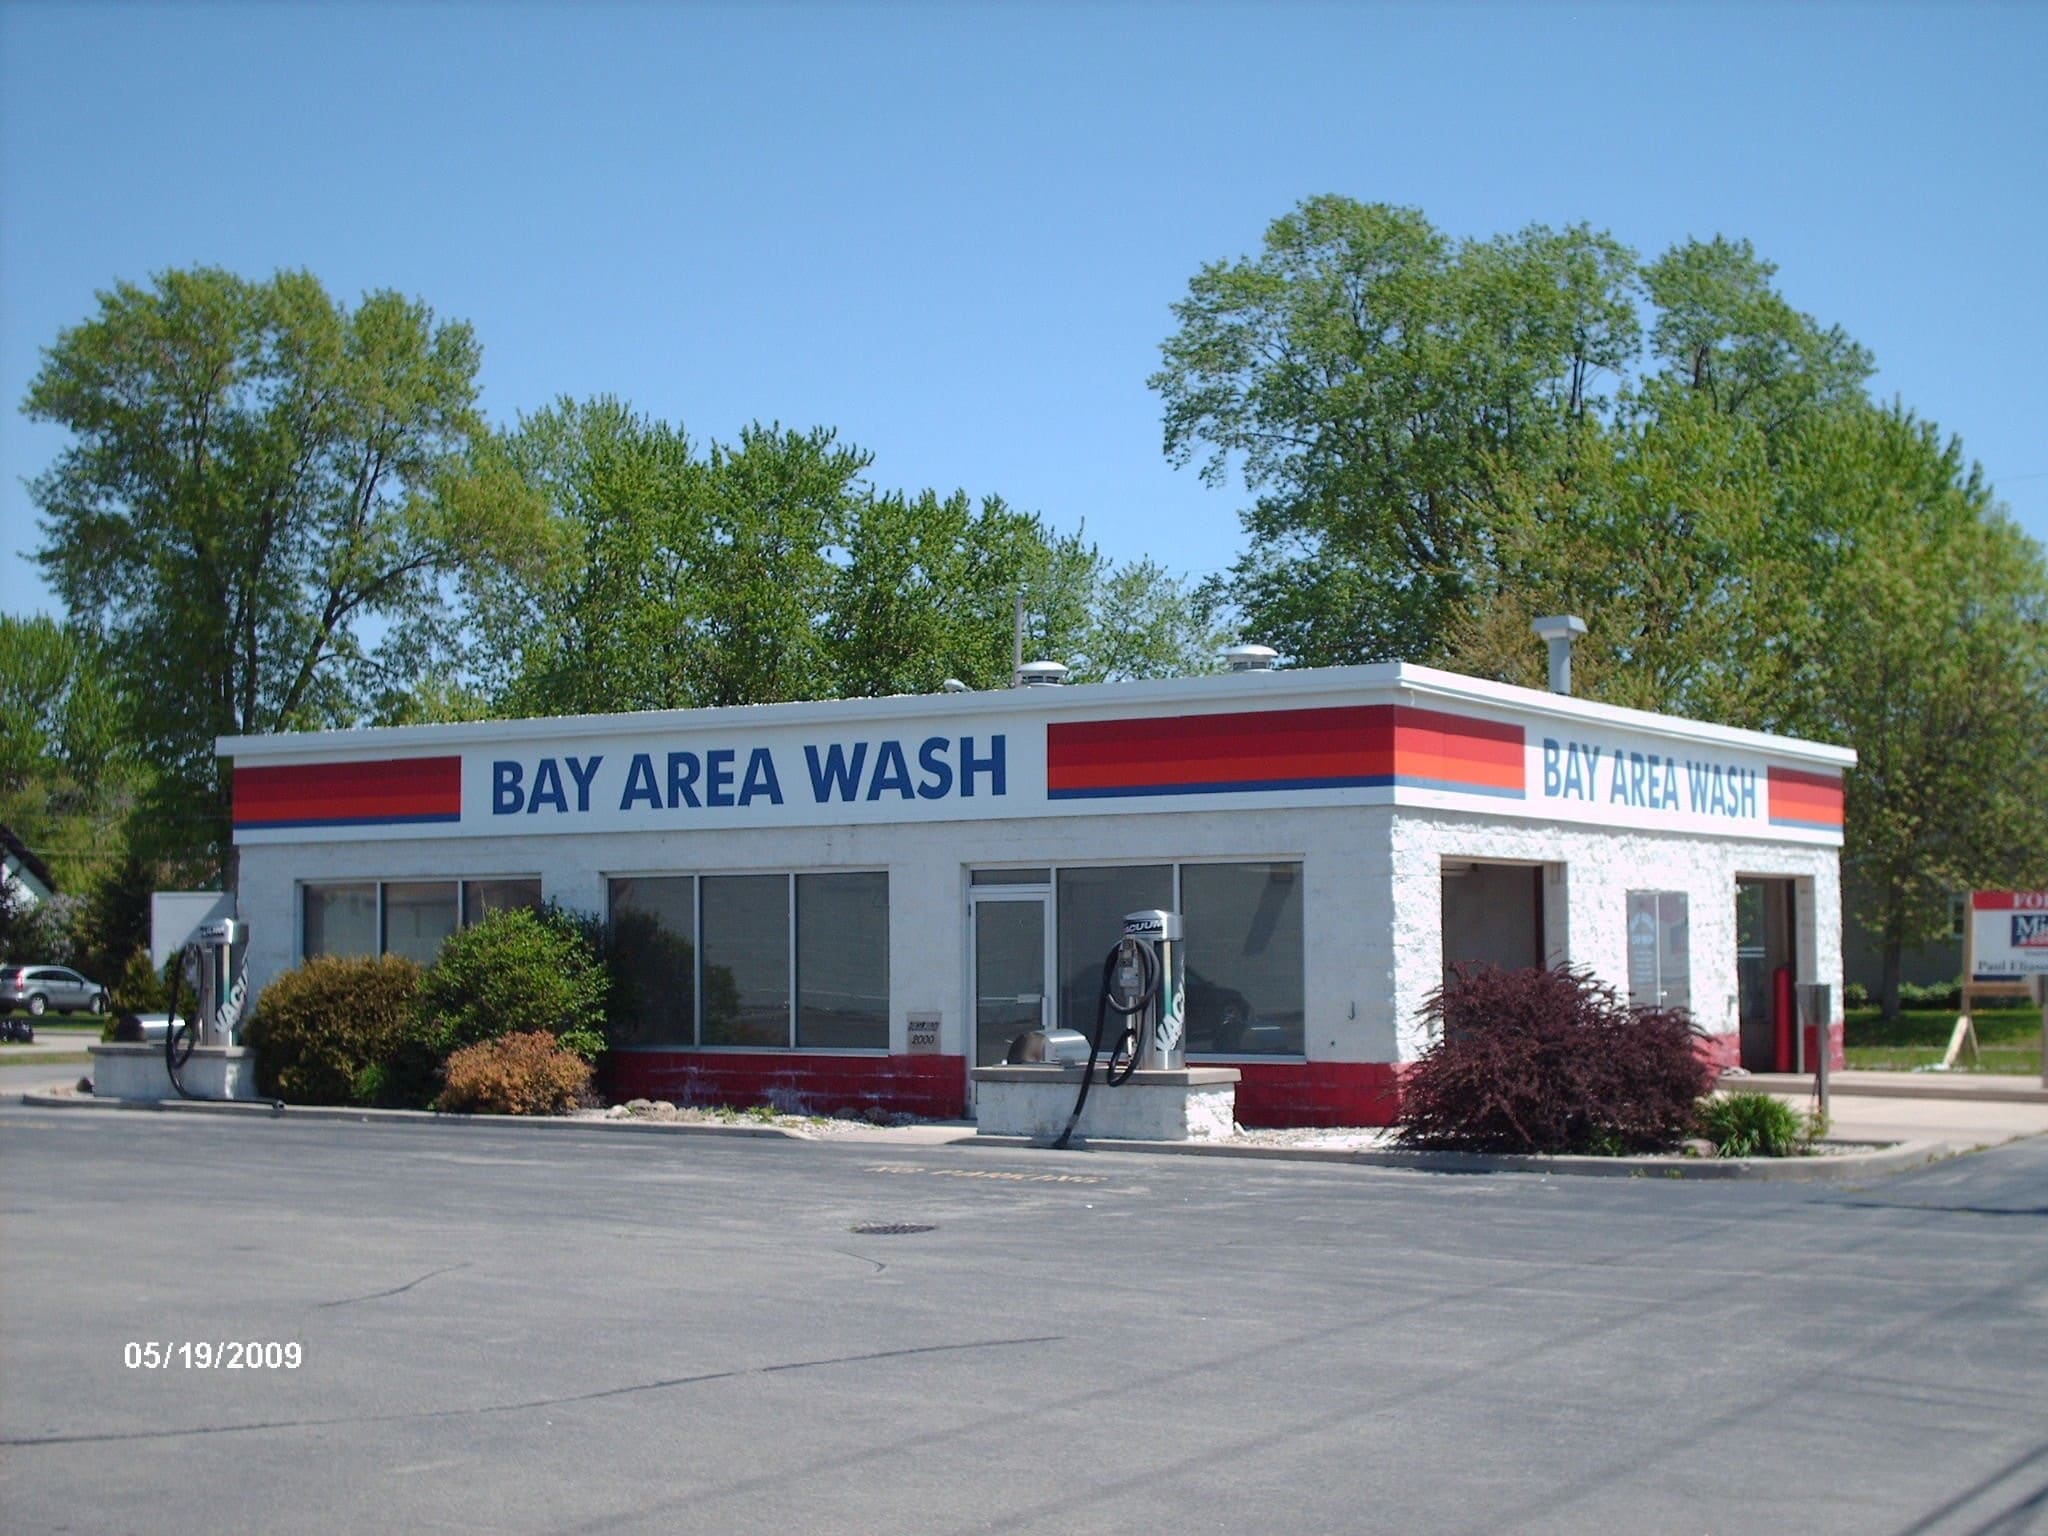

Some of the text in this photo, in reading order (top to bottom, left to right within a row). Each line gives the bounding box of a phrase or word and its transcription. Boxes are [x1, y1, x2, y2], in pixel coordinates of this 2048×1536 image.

[492, 734, 1007, 815] BAY AREA WASH
[1543, 737, 1756, 819] BAY AREA WASH
